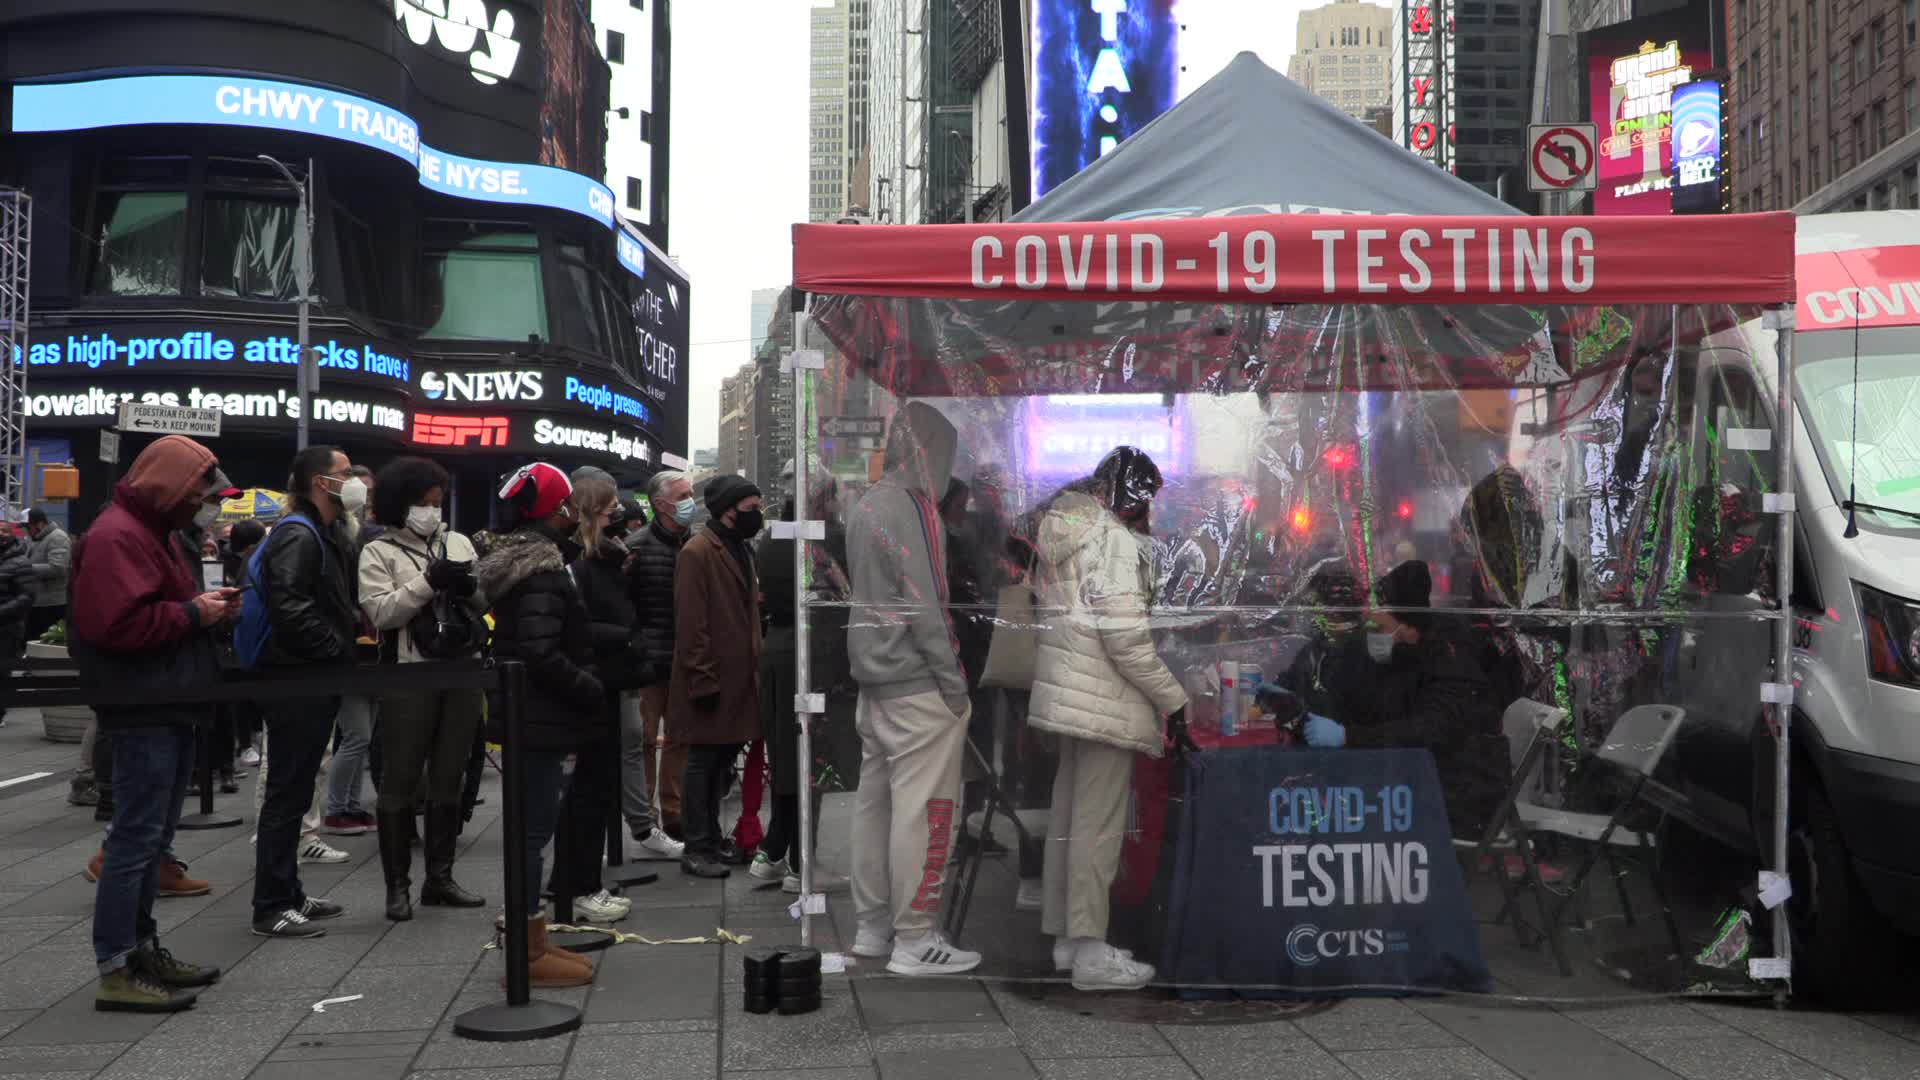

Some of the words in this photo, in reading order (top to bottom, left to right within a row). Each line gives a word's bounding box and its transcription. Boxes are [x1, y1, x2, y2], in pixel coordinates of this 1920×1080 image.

[215, 85, 324, 123] CHWY
[333, 99, 415, 154] TRADES
[446, 159, 528, 195] NYSE.
[1677, 156, 1715, 170] TACO
[1680, 169, 1716, 187] BELL
[1614, 182, 1654, 198] PLAY
[971, 230, 1277, 293] COVID-19
[1312, 227, 1595, 293] TESTING
[29, 343, 61, 364] as
[67, 332, 235, 368] high-profile
[364, 345, 401, 379] have
[636, 327, 676, 384] TCHER
[444, 371, 543, 401] NEWS
[566, 376, 612, 411] People
[134, 407, 177, 418] PEDESTRIAN
[179, 411, 197, 420] FLOW
[199, 411, 217, 421] ZONE
[188, 387, 300, 418] team's
[313, 398, 368, 424] new
[170, 421, 188, 431] KEEP
[189, 423, 217, 433] MOVING
[412, 412, 509, 446] ESPN
[534, 418, 607, 451] Sources:
[609, 430, 631, 460] Jags
[1269, 784, 1413, 834] COVID-19
[1253, 842, 1429, 907] TESTING
